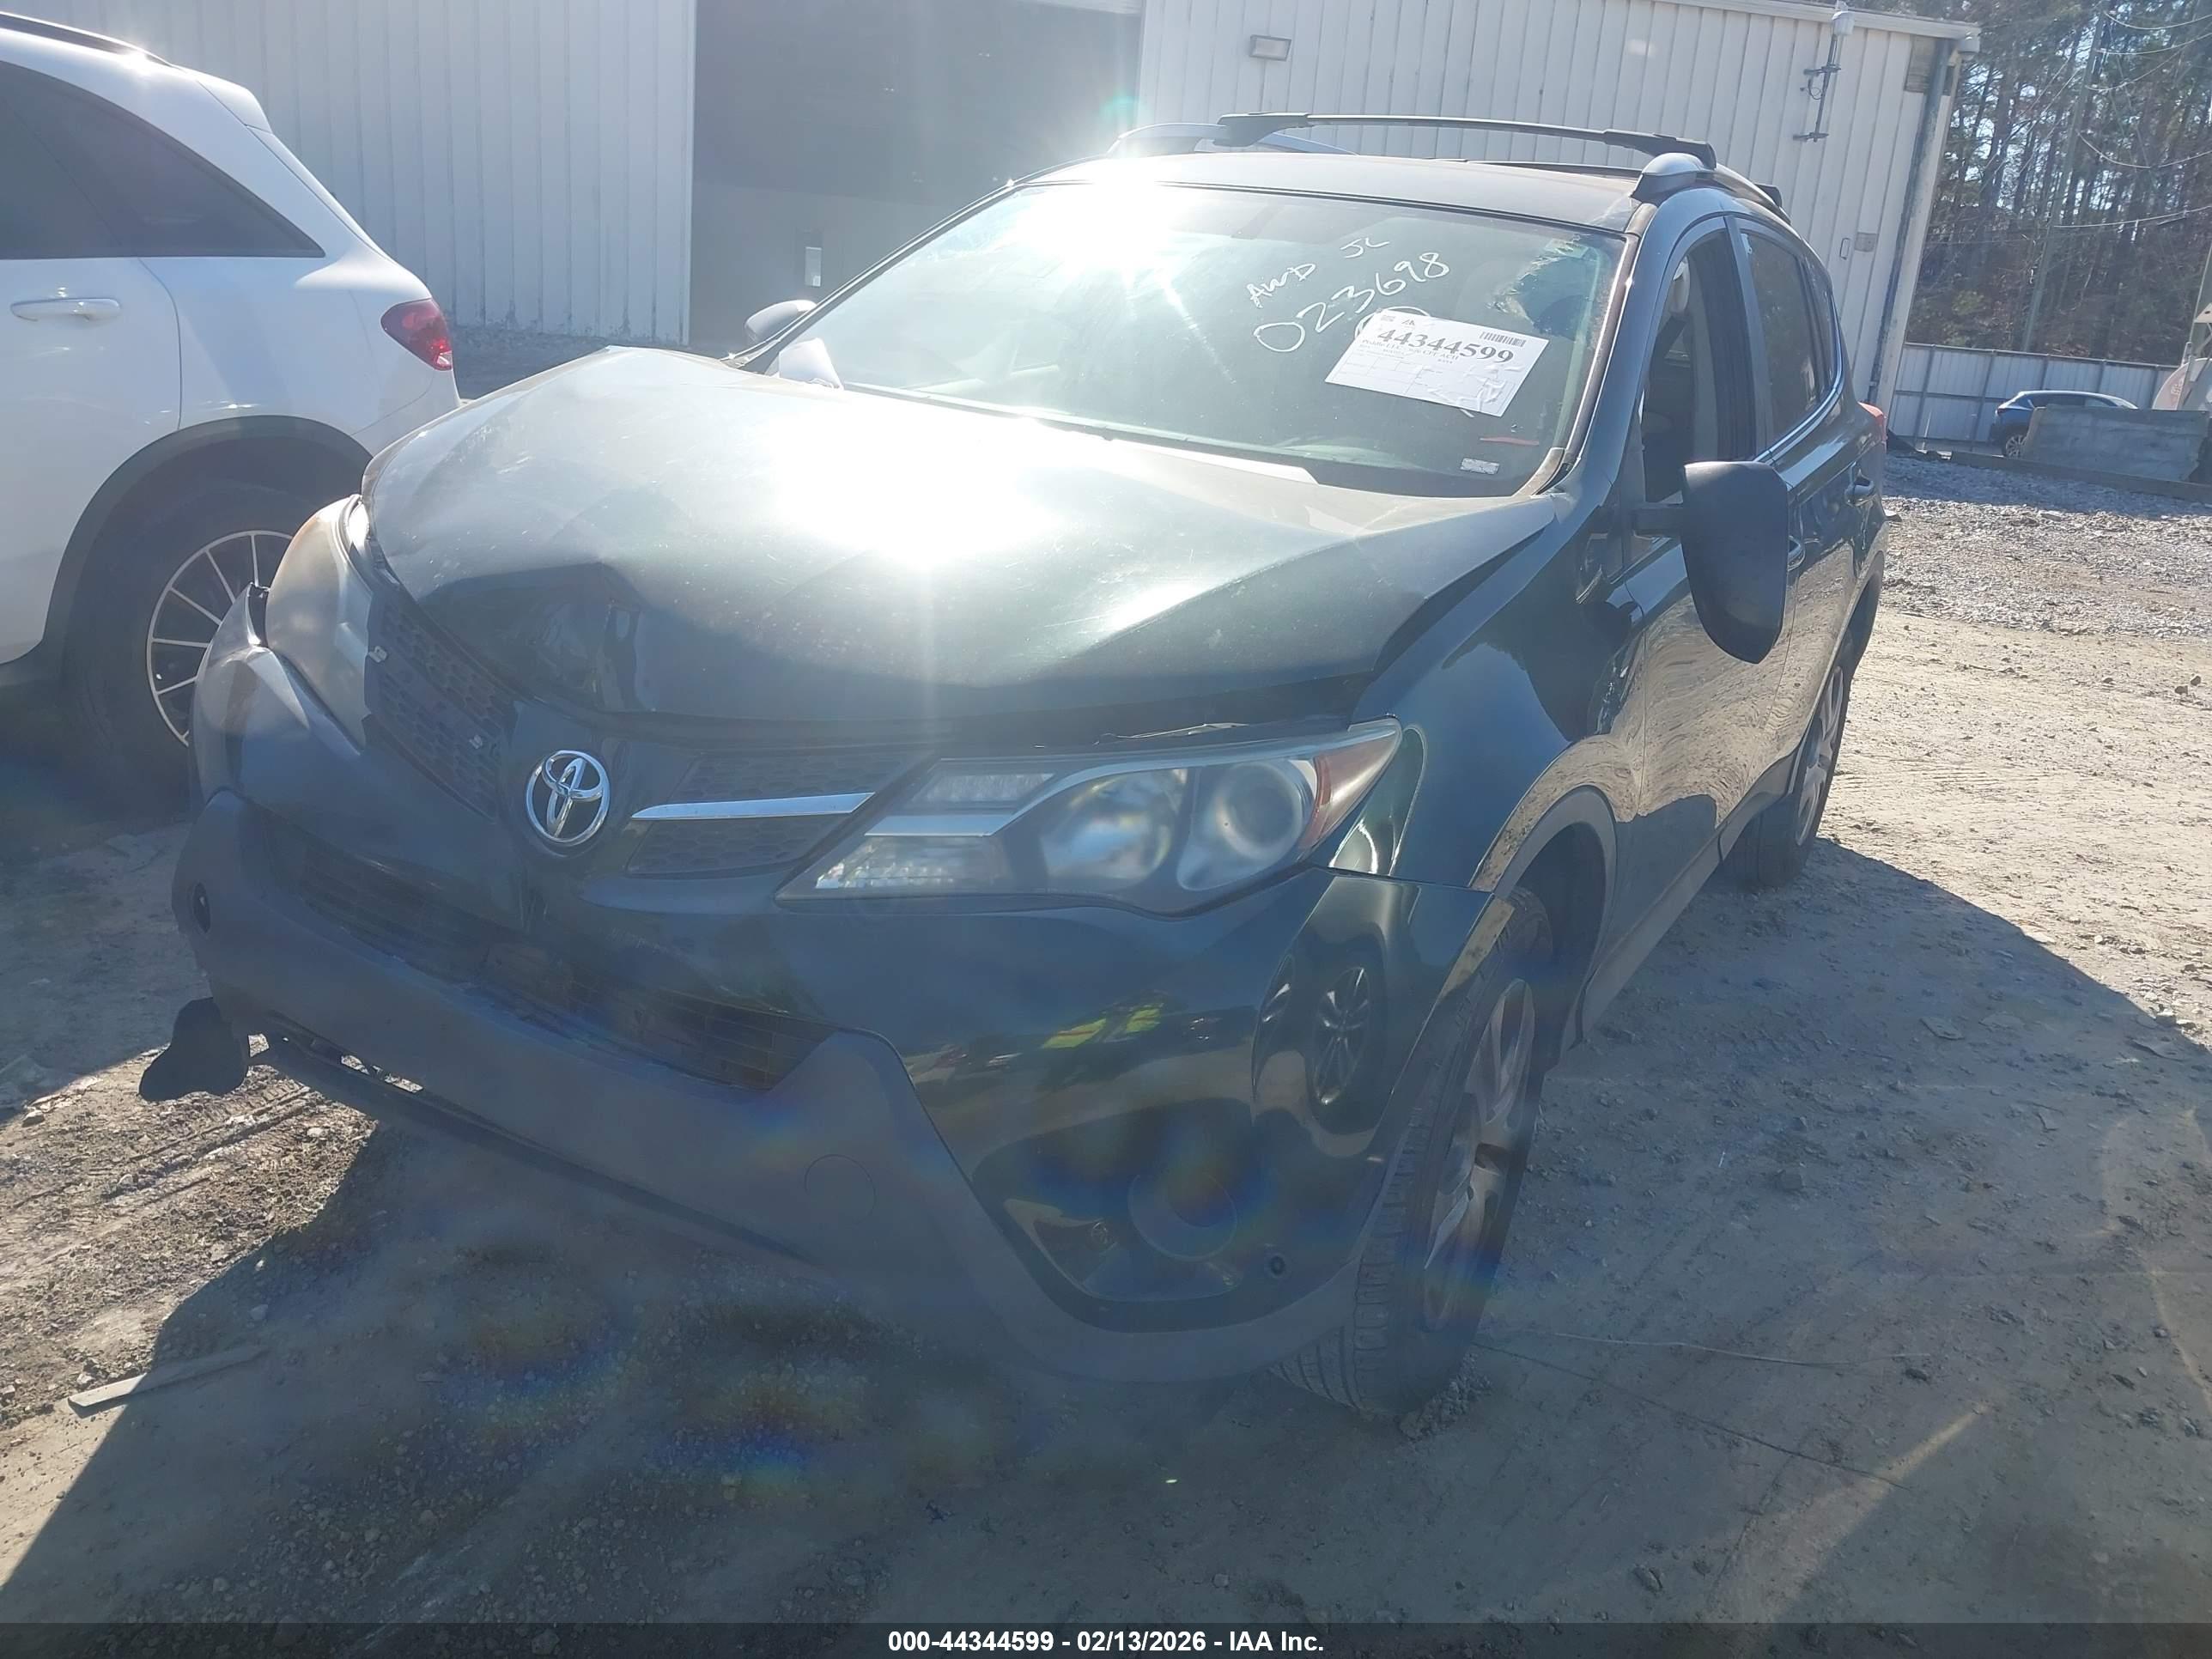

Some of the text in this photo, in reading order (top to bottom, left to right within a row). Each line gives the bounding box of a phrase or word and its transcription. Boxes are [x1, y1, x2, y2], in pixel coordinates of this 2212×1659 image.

[1246, 263, 1316, 308] AWD
[1253, 252, 1451, 353] 023698
[1377, 329, 1514, 363] 44344599
